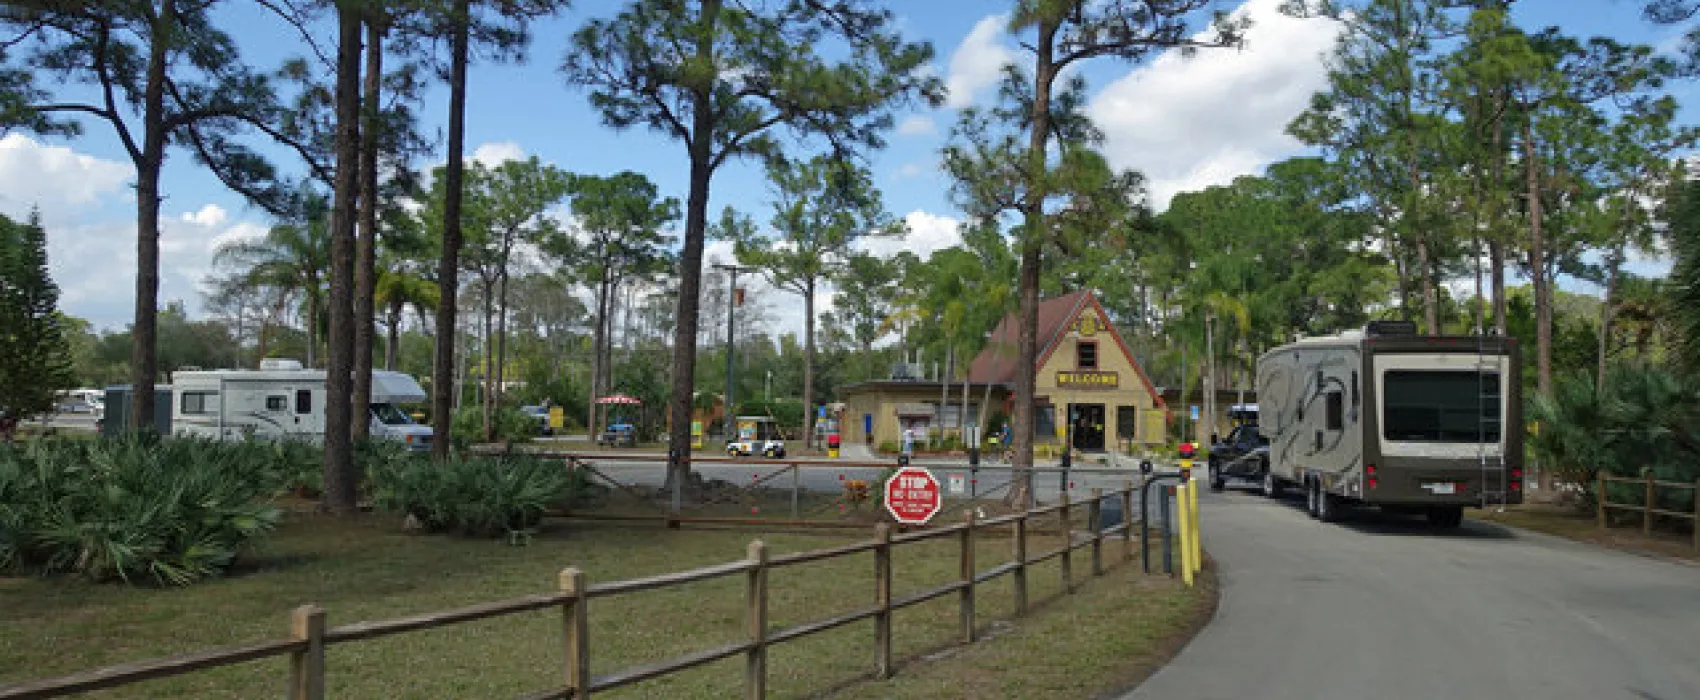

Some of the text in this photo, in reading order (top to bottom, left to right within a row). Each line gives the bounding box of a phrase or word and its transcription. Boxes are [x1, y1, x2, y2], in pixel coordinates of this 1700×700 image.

[1058, 373, 1117, 385] WELCOME
[899, 476, 928, 489] STOP
[892, 490, 933, 500] NO ENTRY
